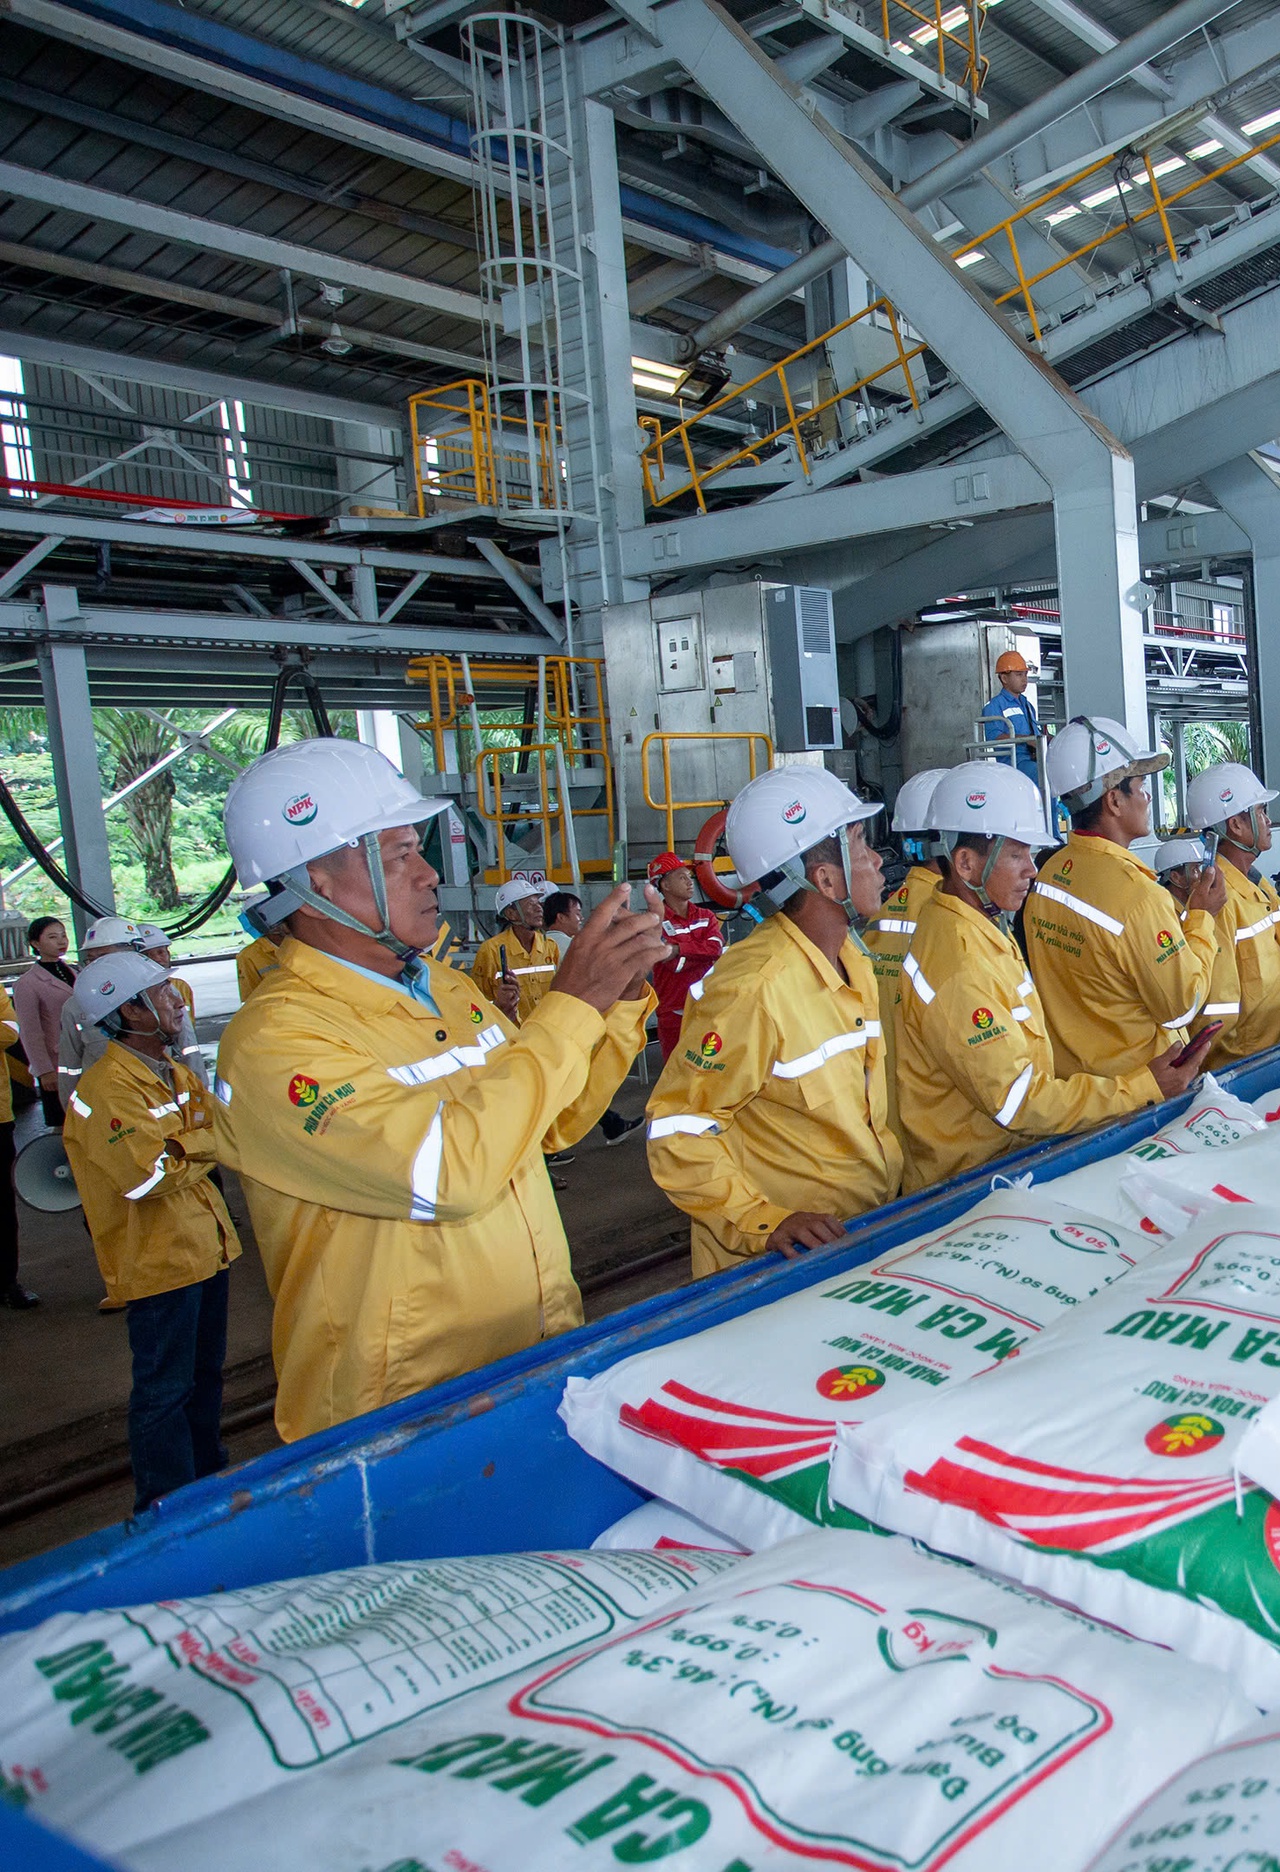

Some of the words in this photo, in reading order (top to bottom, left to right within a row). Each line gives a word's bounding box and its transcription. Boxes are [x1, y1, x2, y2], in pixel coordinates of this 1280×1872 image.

[287, 797, 313, 818] NPK
[785, 802, 802, 819] NPK
[303, 1116, 319, 1136] PHÂN
[312, 1102, 328, 1119] BÓN
[324, 1093, 337, 1106] CÀ
[337, 1082, 356, 1100] MAU
[1062, 1225, 1083, 1243] kg
[1085, 1234, 1109, 1250] 50
[924, 1248, 973, 1264] 46,3%
[1213, 1261, 1272, 1282] 0,99%
[1014, 1274, 1041, 1293] số
[820, 1279, 924, 1319] MAU
[916, 1302, 986, 1341] CÀ
[1104, 1310, 1230, 1351] MAU
[829, 1335, 864, 1356] MAU
[861, 1345, 884, 1364] CÀ
[882, 1352, 914, 1374] BÓN
[909, 1363, 950, 1387] PHÂN
[1172, 1373, 1206, 1390] VÀNG
[1139, 1379, 1184, 1406] MAU
[1181, 1389, 1210, 1408] CÀ
[1209, 1394, 1243, 1417] BÓN
[729, 1612, 804, 1645] 0,5%
[902, 1621, 936, 1654] kg
[664, 1625, 763, 1665] 0,99%
[619, 1647, 717, 1687] 46,3%
[996, 1713, 1038, 1746] Độ
[387, 1733, 618, 1808] MAU
[563, 1773, 711, 1865] CÀ
